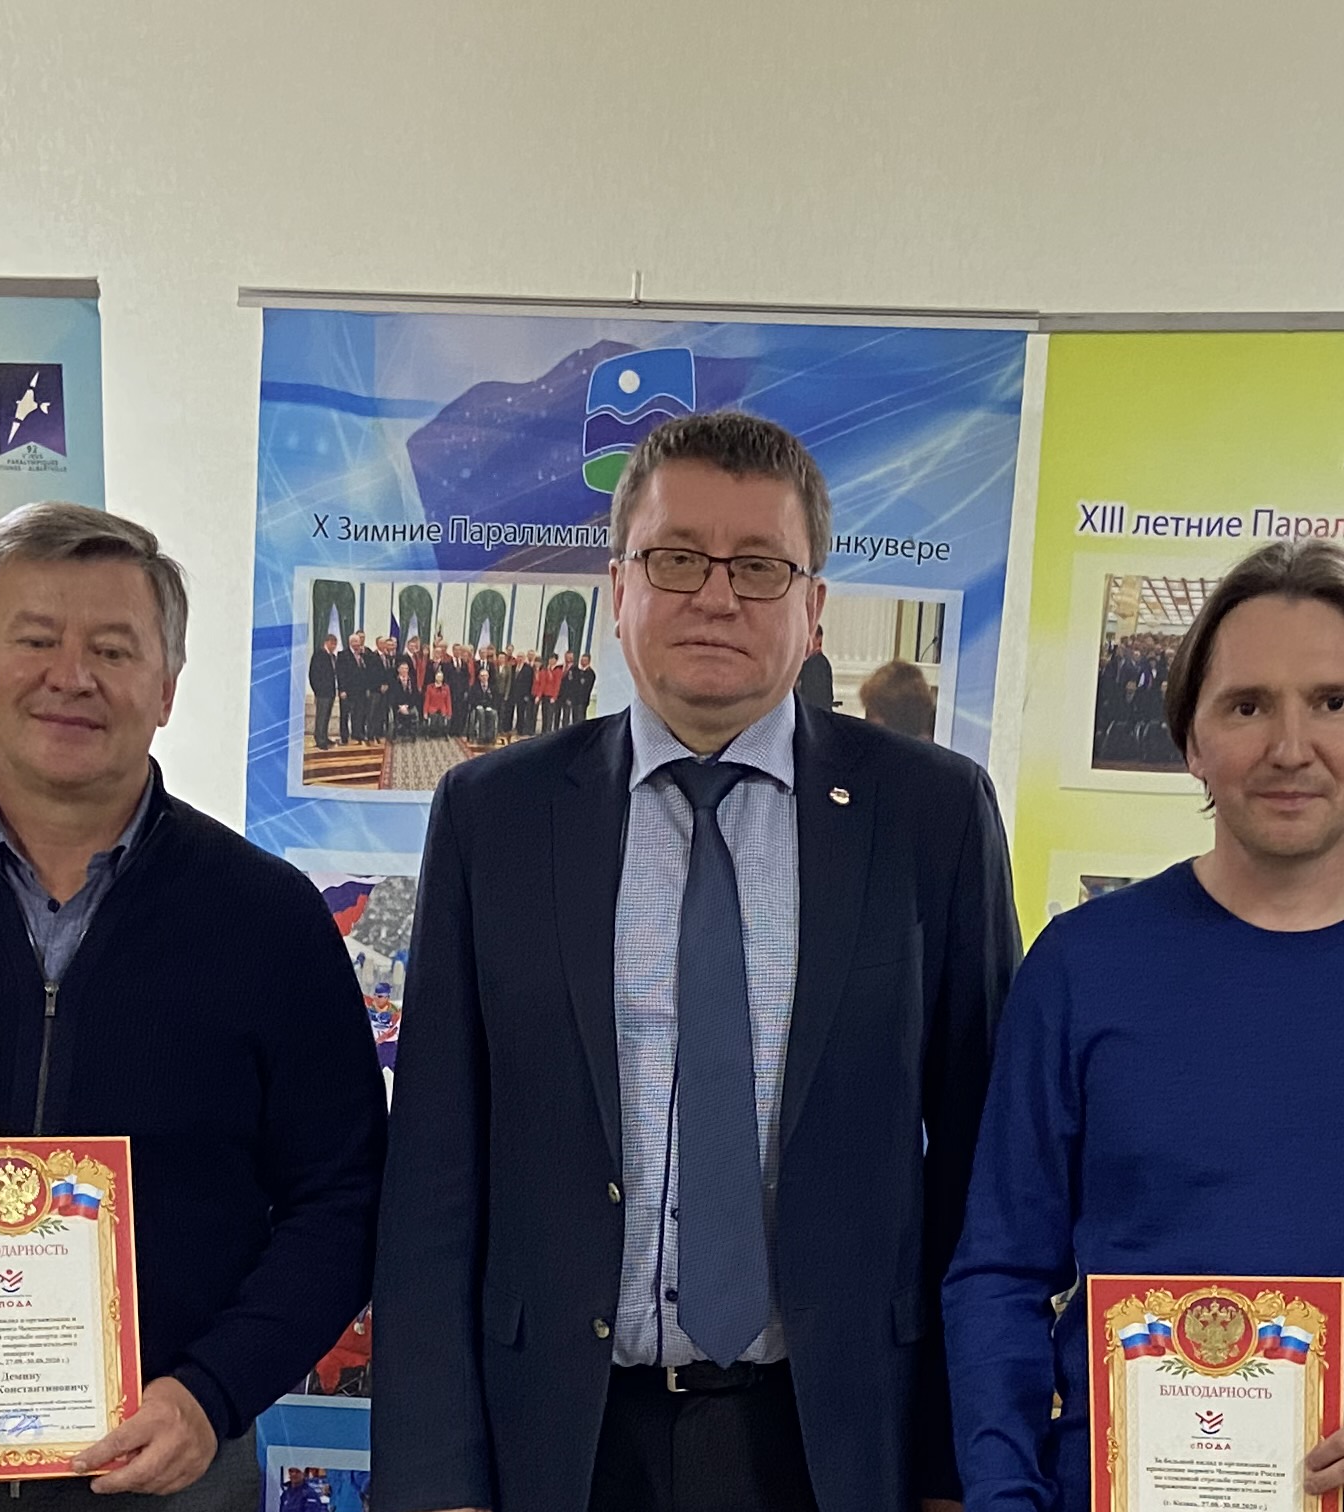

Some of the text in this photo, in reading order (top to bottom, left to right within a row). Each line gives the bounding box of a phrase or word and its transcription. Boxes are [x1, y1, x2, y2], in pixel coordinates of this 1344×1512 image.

[1079, 504, 1125, 533] XIII
[1132, 513, 1243, 538] летние
[336, 516, 442, 542] Зимние
[830, 535, 950, 565] нкувере
[1, 1371, 41, 1382] Демину
[1159, 1384, 1273, 1400] БЛАГОДАРНОСТЬ
